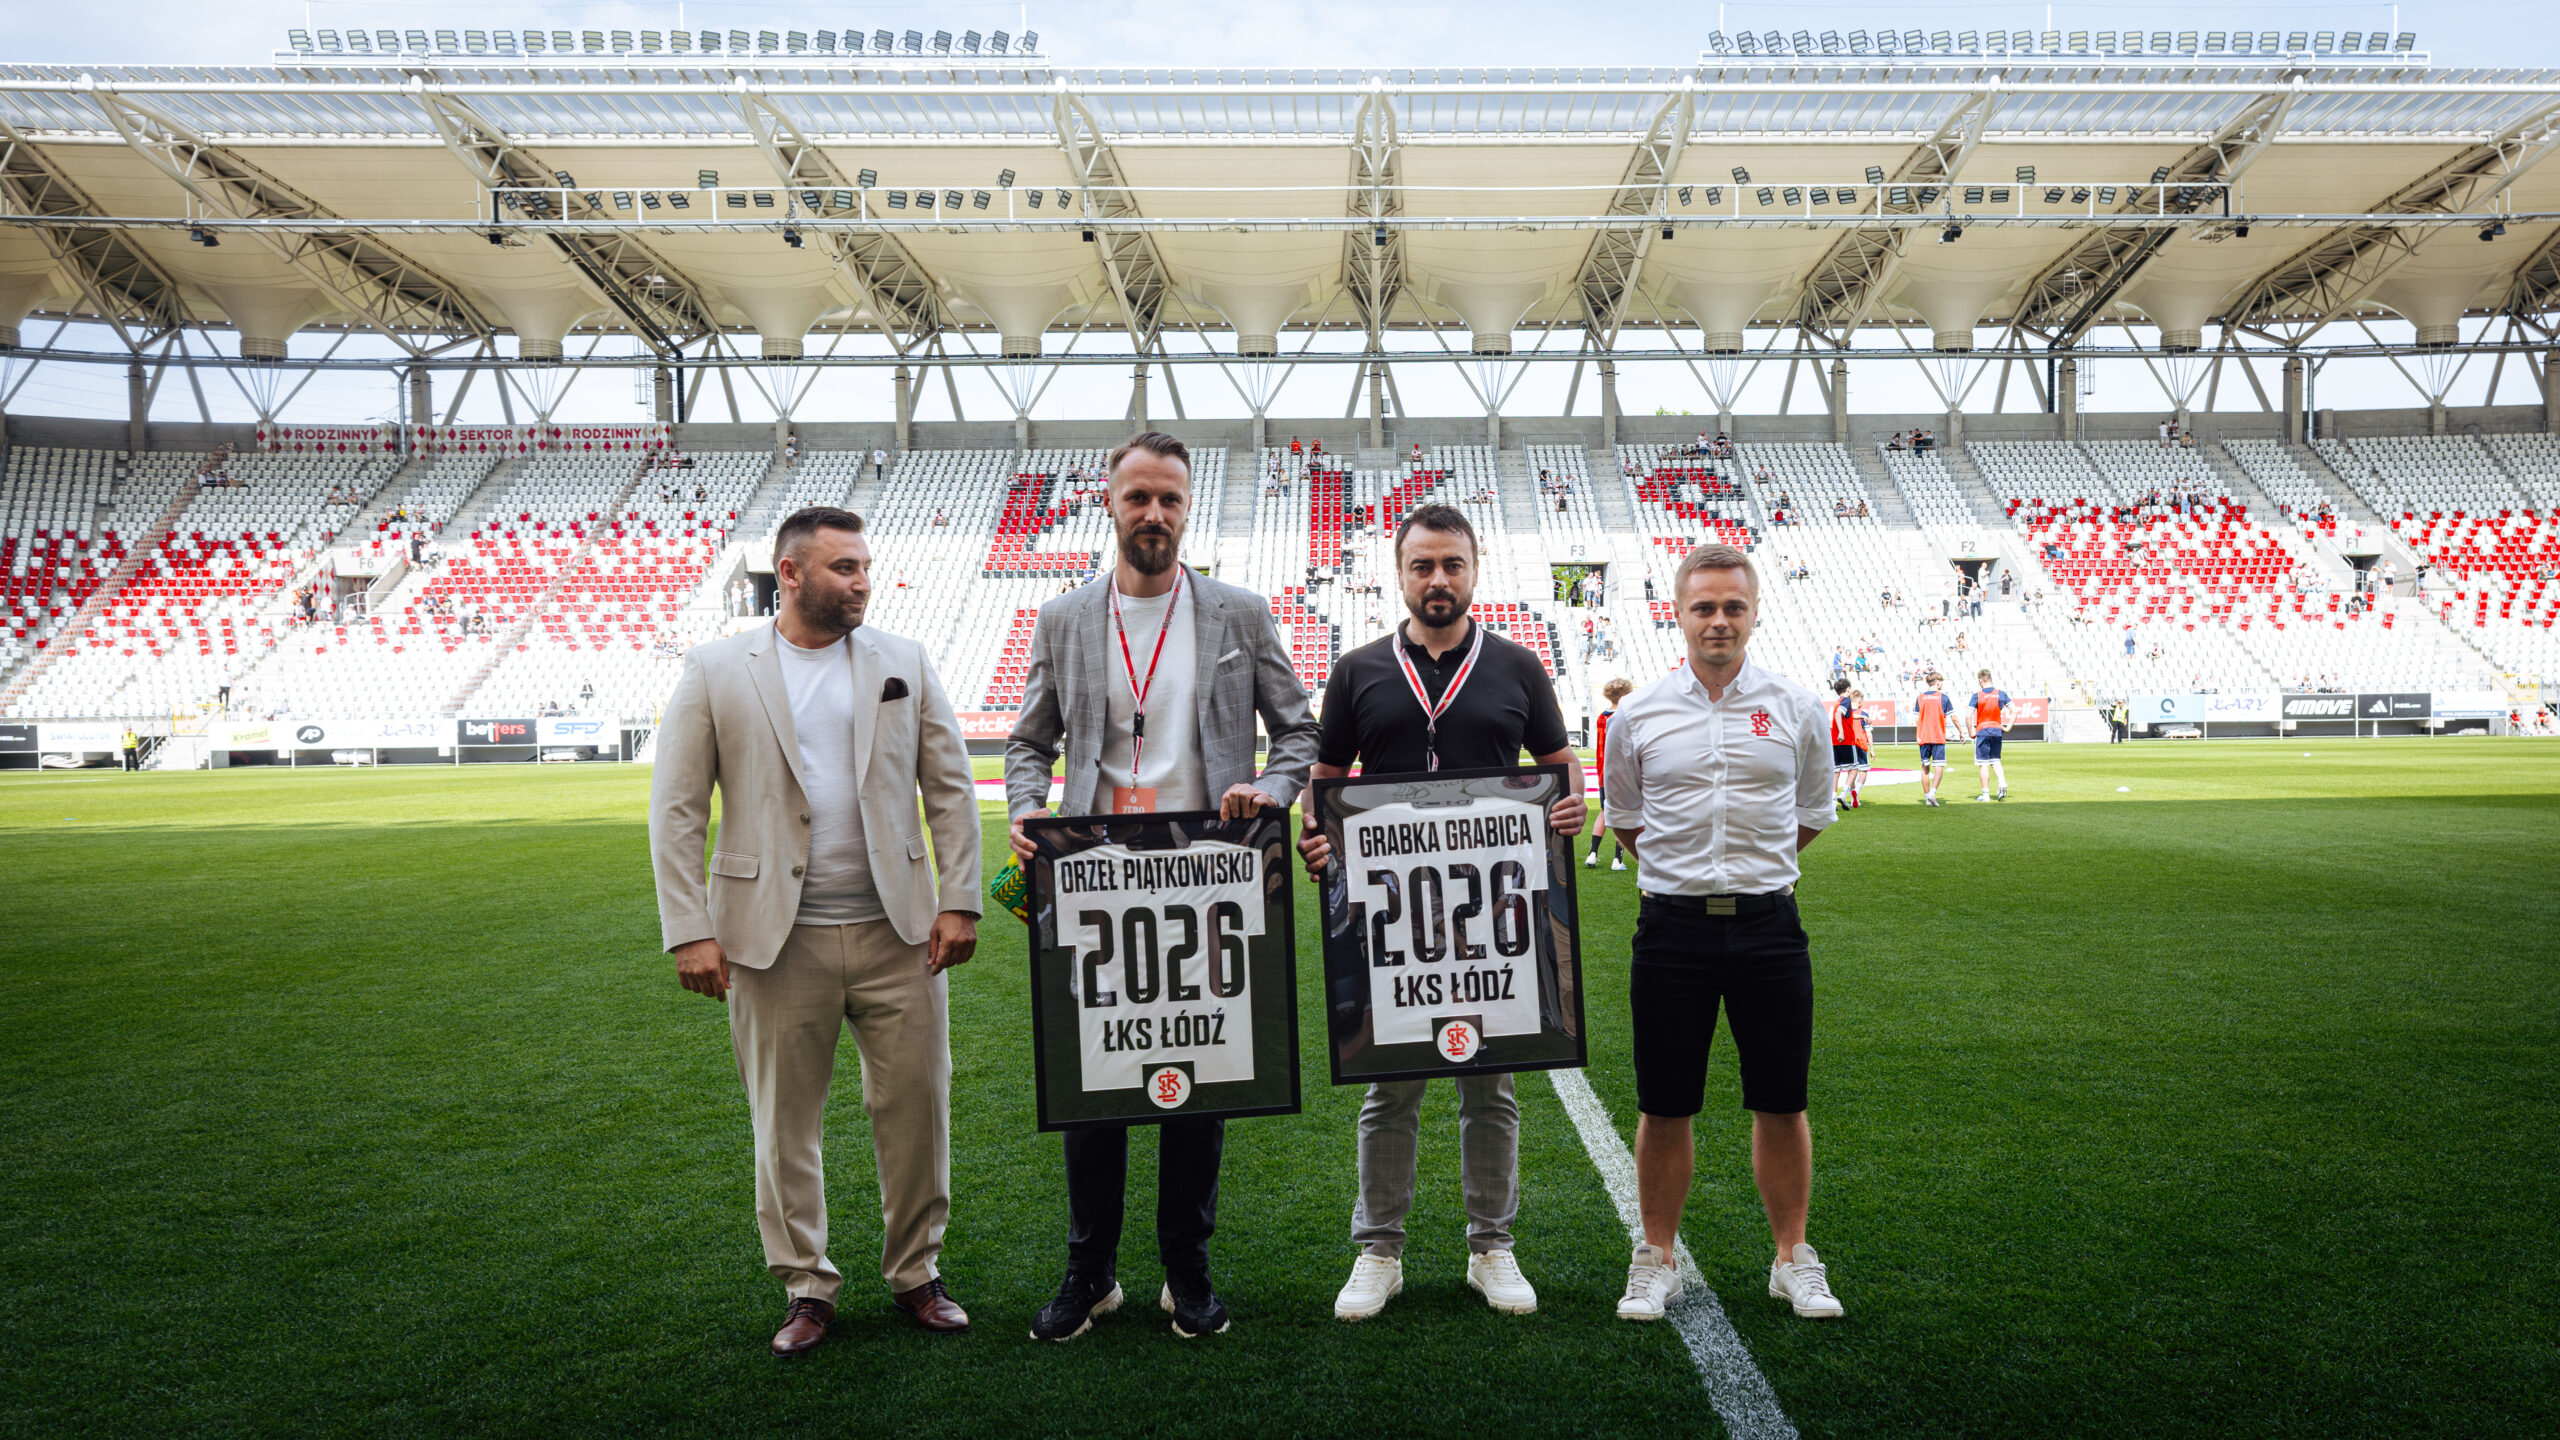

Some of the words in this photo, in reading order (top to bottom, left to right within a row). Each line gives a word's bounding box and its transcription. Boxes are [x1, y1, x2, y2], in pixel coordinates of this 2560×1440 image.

[294, 429, 369, 441] RODZINNY
[459, 429, 513, 441] SEKTOR
[572, 428, 642, 440] RODZINNY
[1570, 544, 1586, 557] F3
[1961, 540, 1976, 553] F2
[2346, 537, 2359, 549] F1
[359, 557, 374, 569] F6
[2284, 699, 2353, 716] 4MOVE
[465, 721, 526, 743] betters
[958, 716, 1017, 733] Betclic
[232, 728, 269, 742] Kramel
[1358, 821, 1441, 858] GRABKA
[1445, 813, 1533, 850] GRABICA
[1060, 858, 1118, 894] ORZEŁ
[1123, 850, 1254, 895] PIĄTKOWISKO
[1367, 859, 1531, 968] 2026
[1078, 900, 1246, 1009] 2026
[1393, 972, 1443, 1009] ŁKS
[1450, 962, 1515, 1005] ŁÓDŹ
[1103, 1017, 1153, 1053] ŁKS
[1160, 1007, 1226, 1050] ŁÓDŹ
